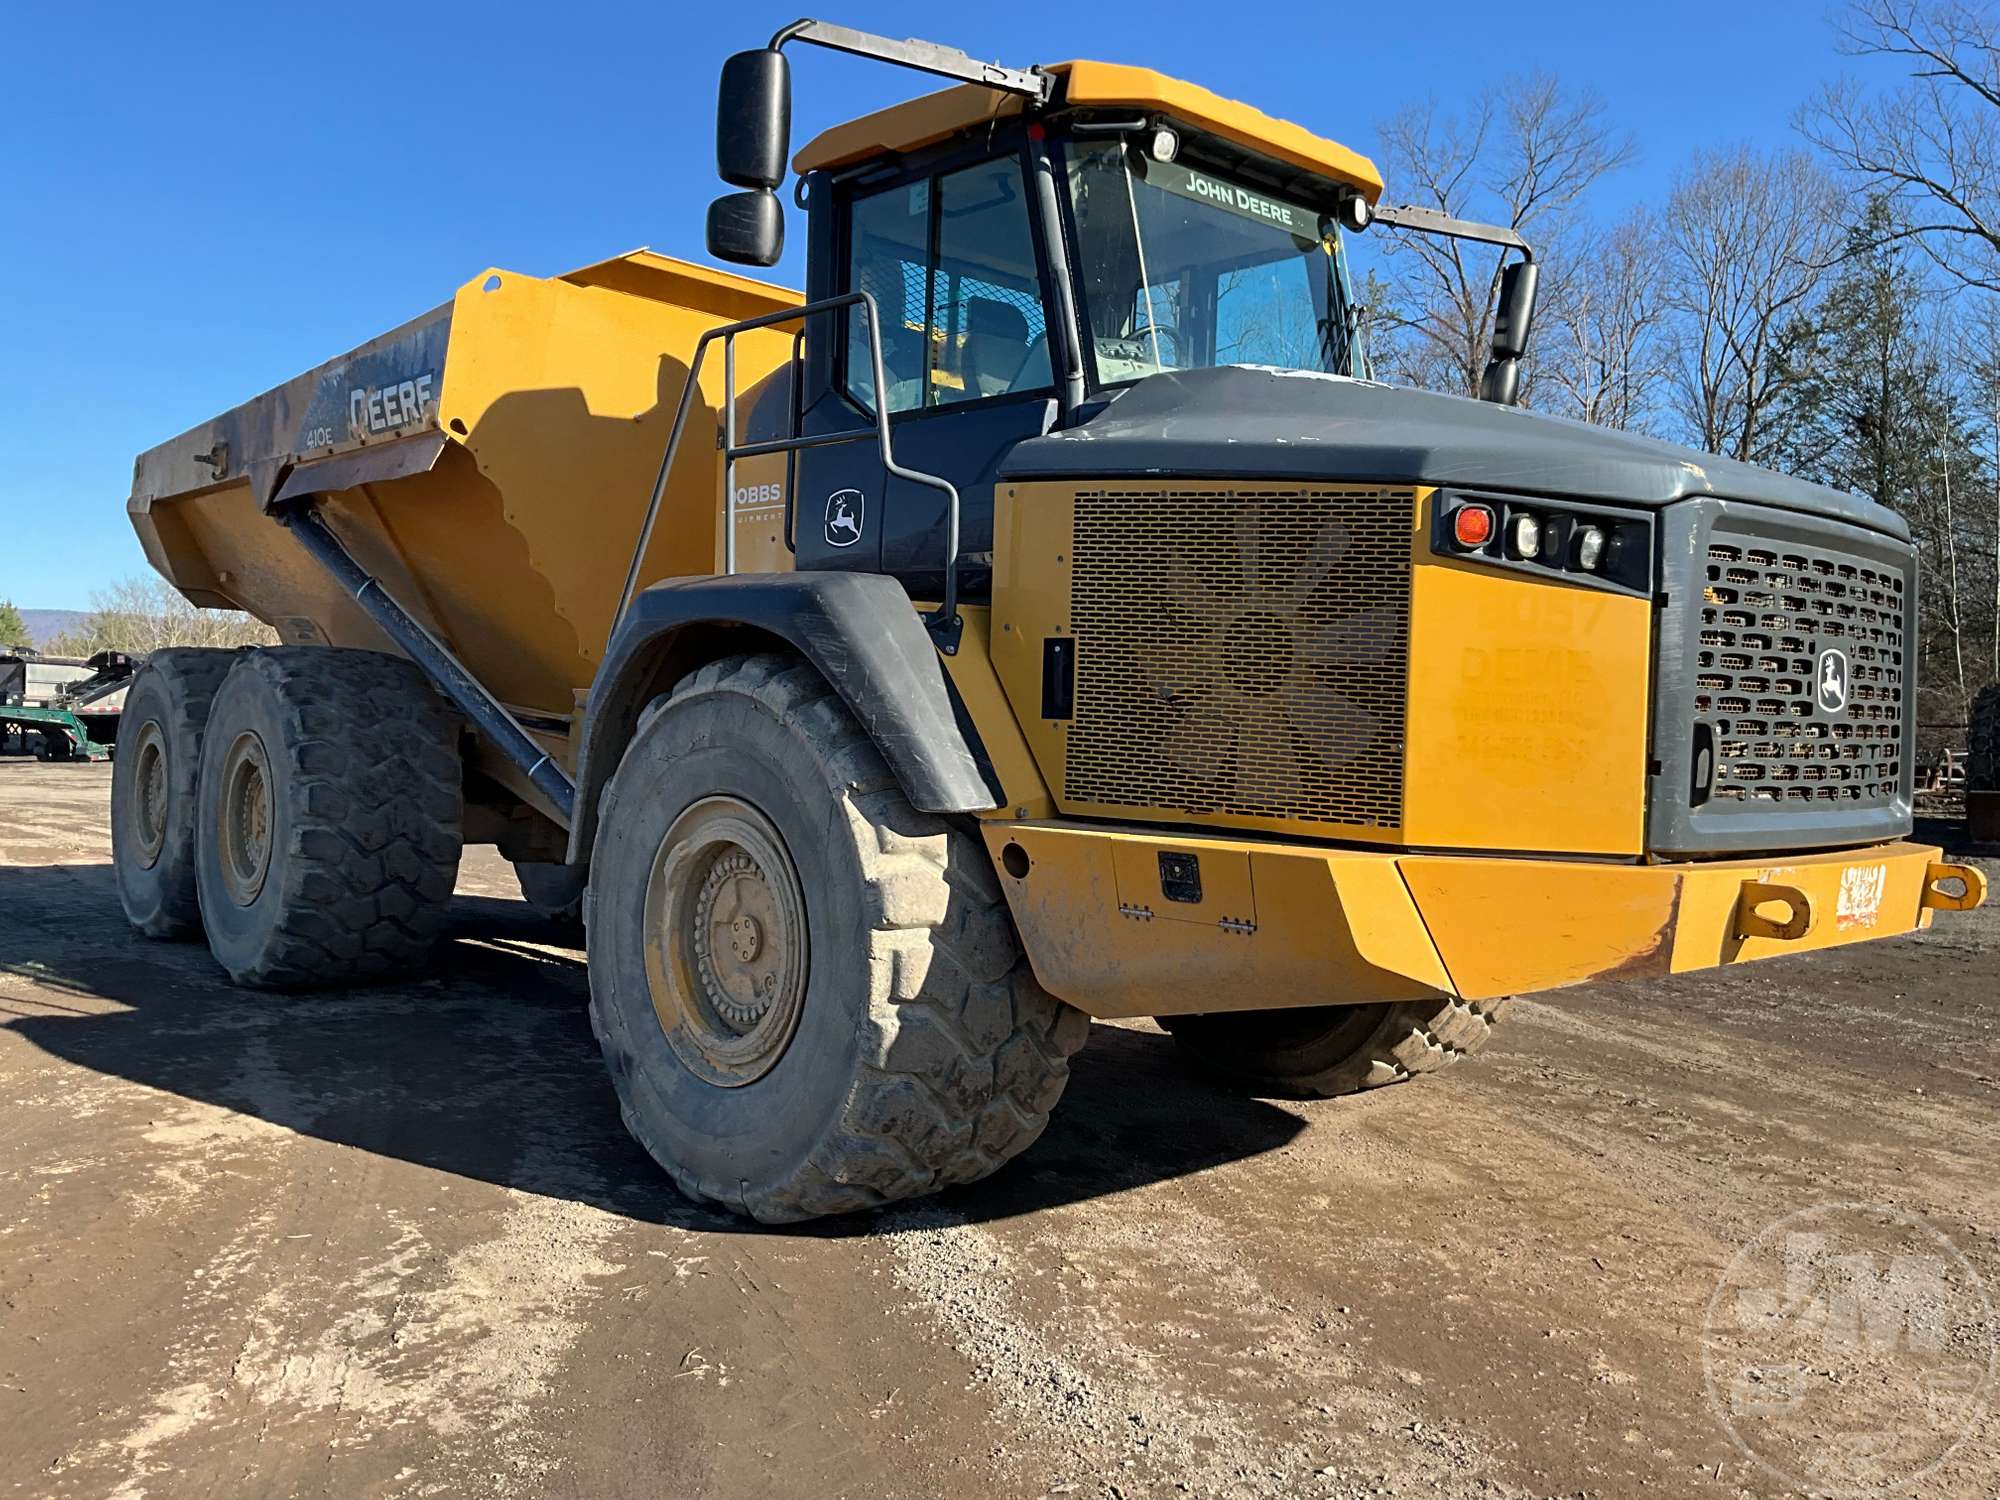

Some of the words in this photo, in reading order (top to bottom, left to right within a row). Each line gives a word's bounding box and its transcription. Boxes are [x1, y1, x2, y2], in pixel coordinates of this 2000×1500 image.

[1186, 172, 1234, 206] JOHN
[1235, 188, 1294, 226] DEERE
[306, 427, 333, 449] 410E
[734, 483, 781, 504] OBBS
